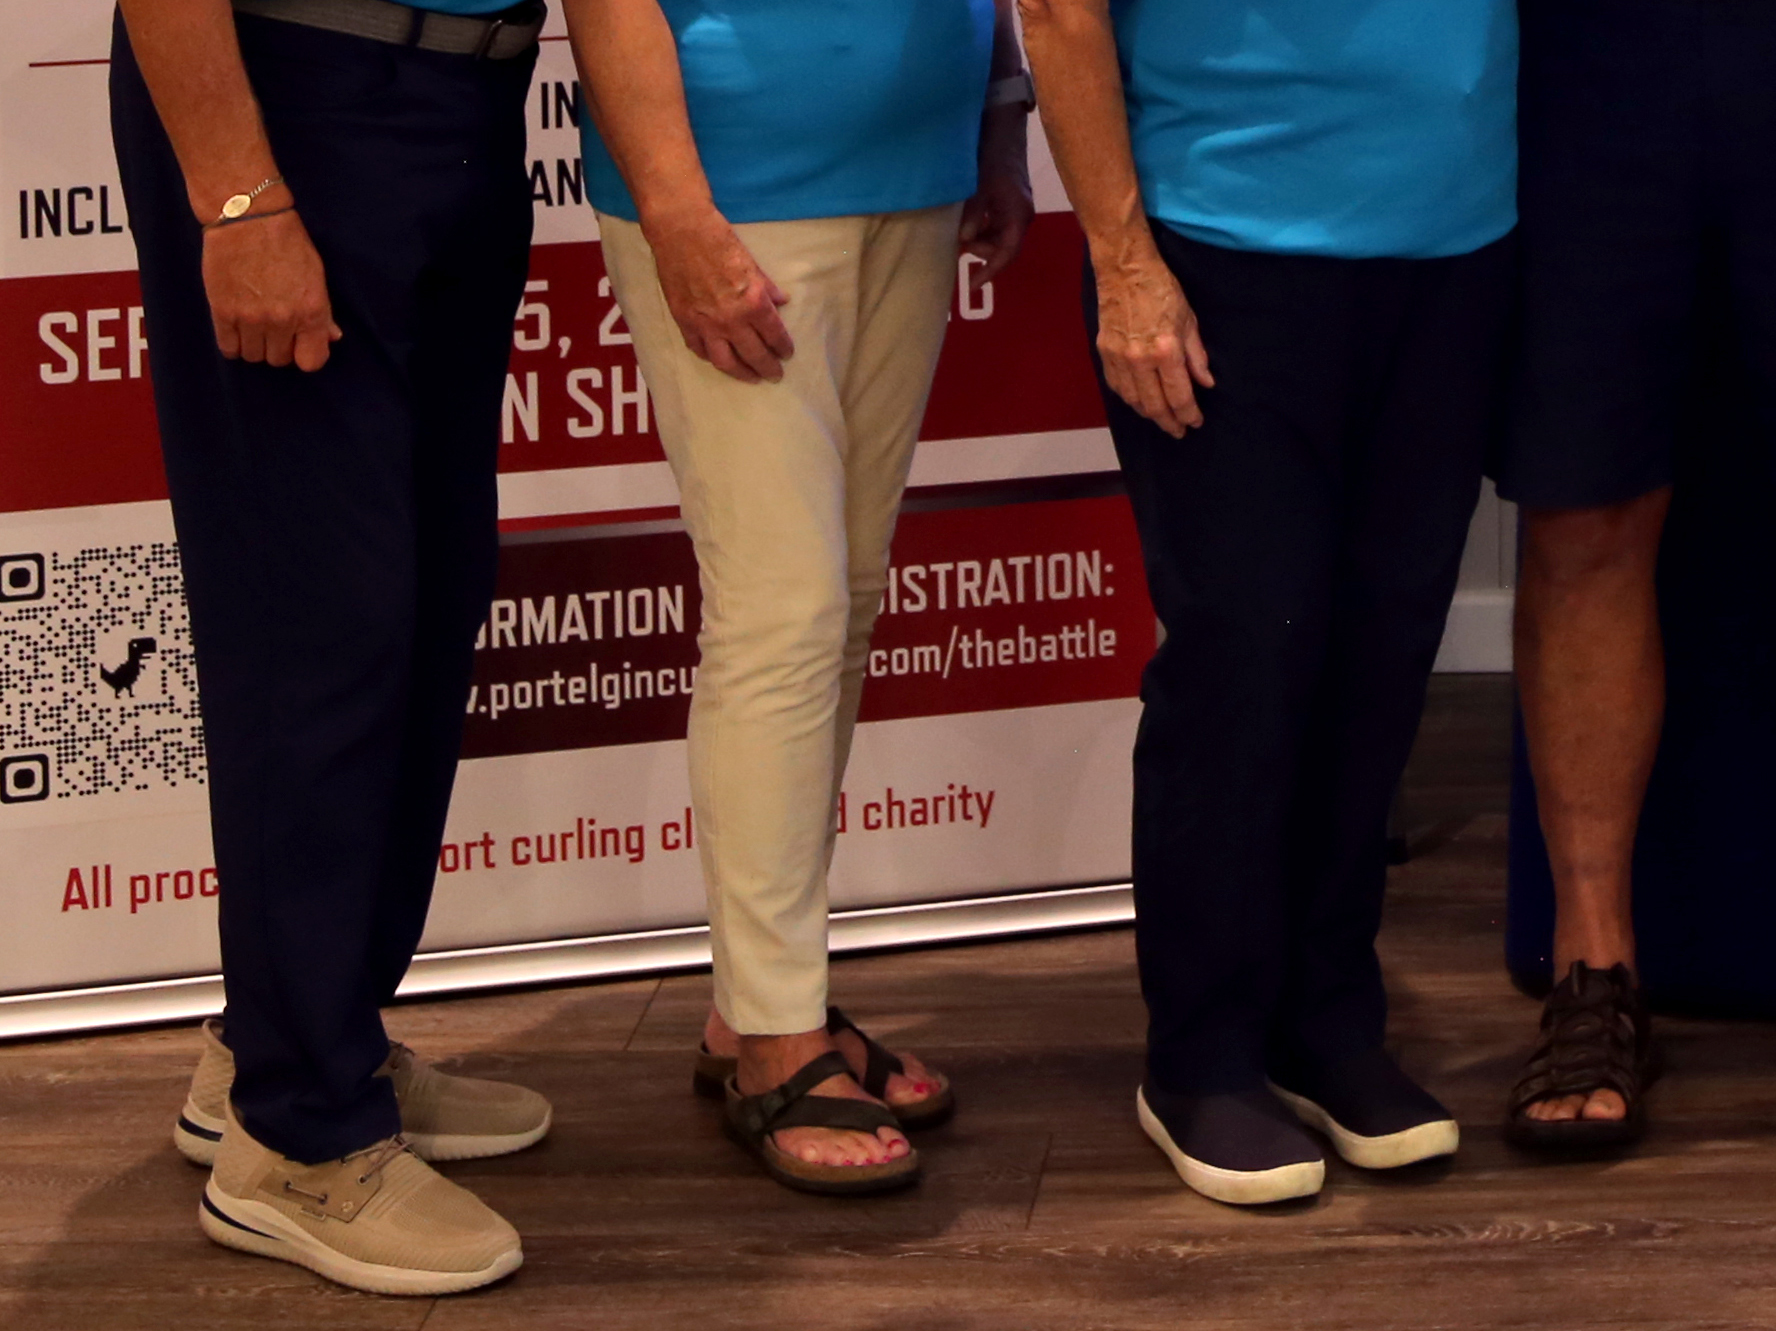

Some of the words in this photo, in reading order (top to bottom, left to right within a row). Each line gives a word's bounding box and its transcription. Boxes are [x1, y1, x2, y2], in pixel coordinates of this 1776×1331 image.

[877, 550, 1115, 615] ISTRATION:
[61, 864, 112, 913] All
[511, 817, 645, 866] curling
[863, 783, 995, 831] charity
